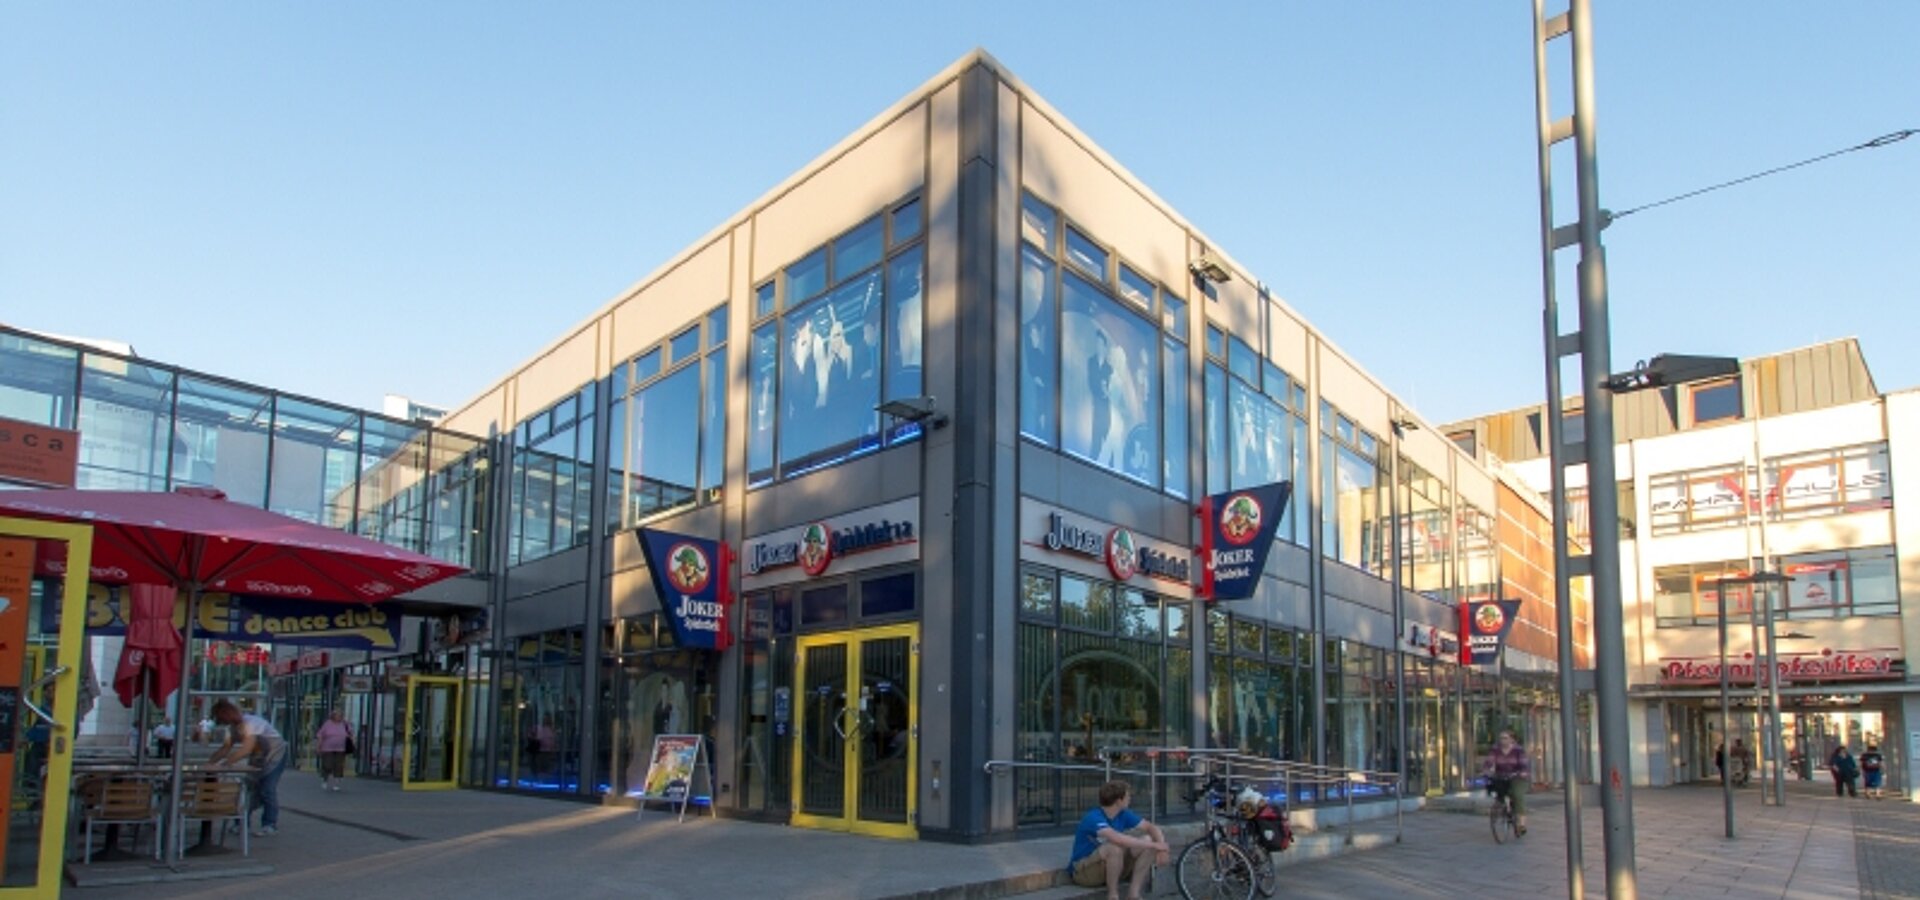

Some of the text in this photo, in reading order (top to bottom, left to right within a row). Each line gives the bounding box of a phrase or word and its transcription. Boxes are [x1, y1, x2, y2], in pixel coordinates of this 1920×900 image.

[1206, 549, 1254, 570] JOKER
[676, 595, 724, 618] JOKER
[244, 614, 330, 635] dance
[333, 607, 388, 627] club
